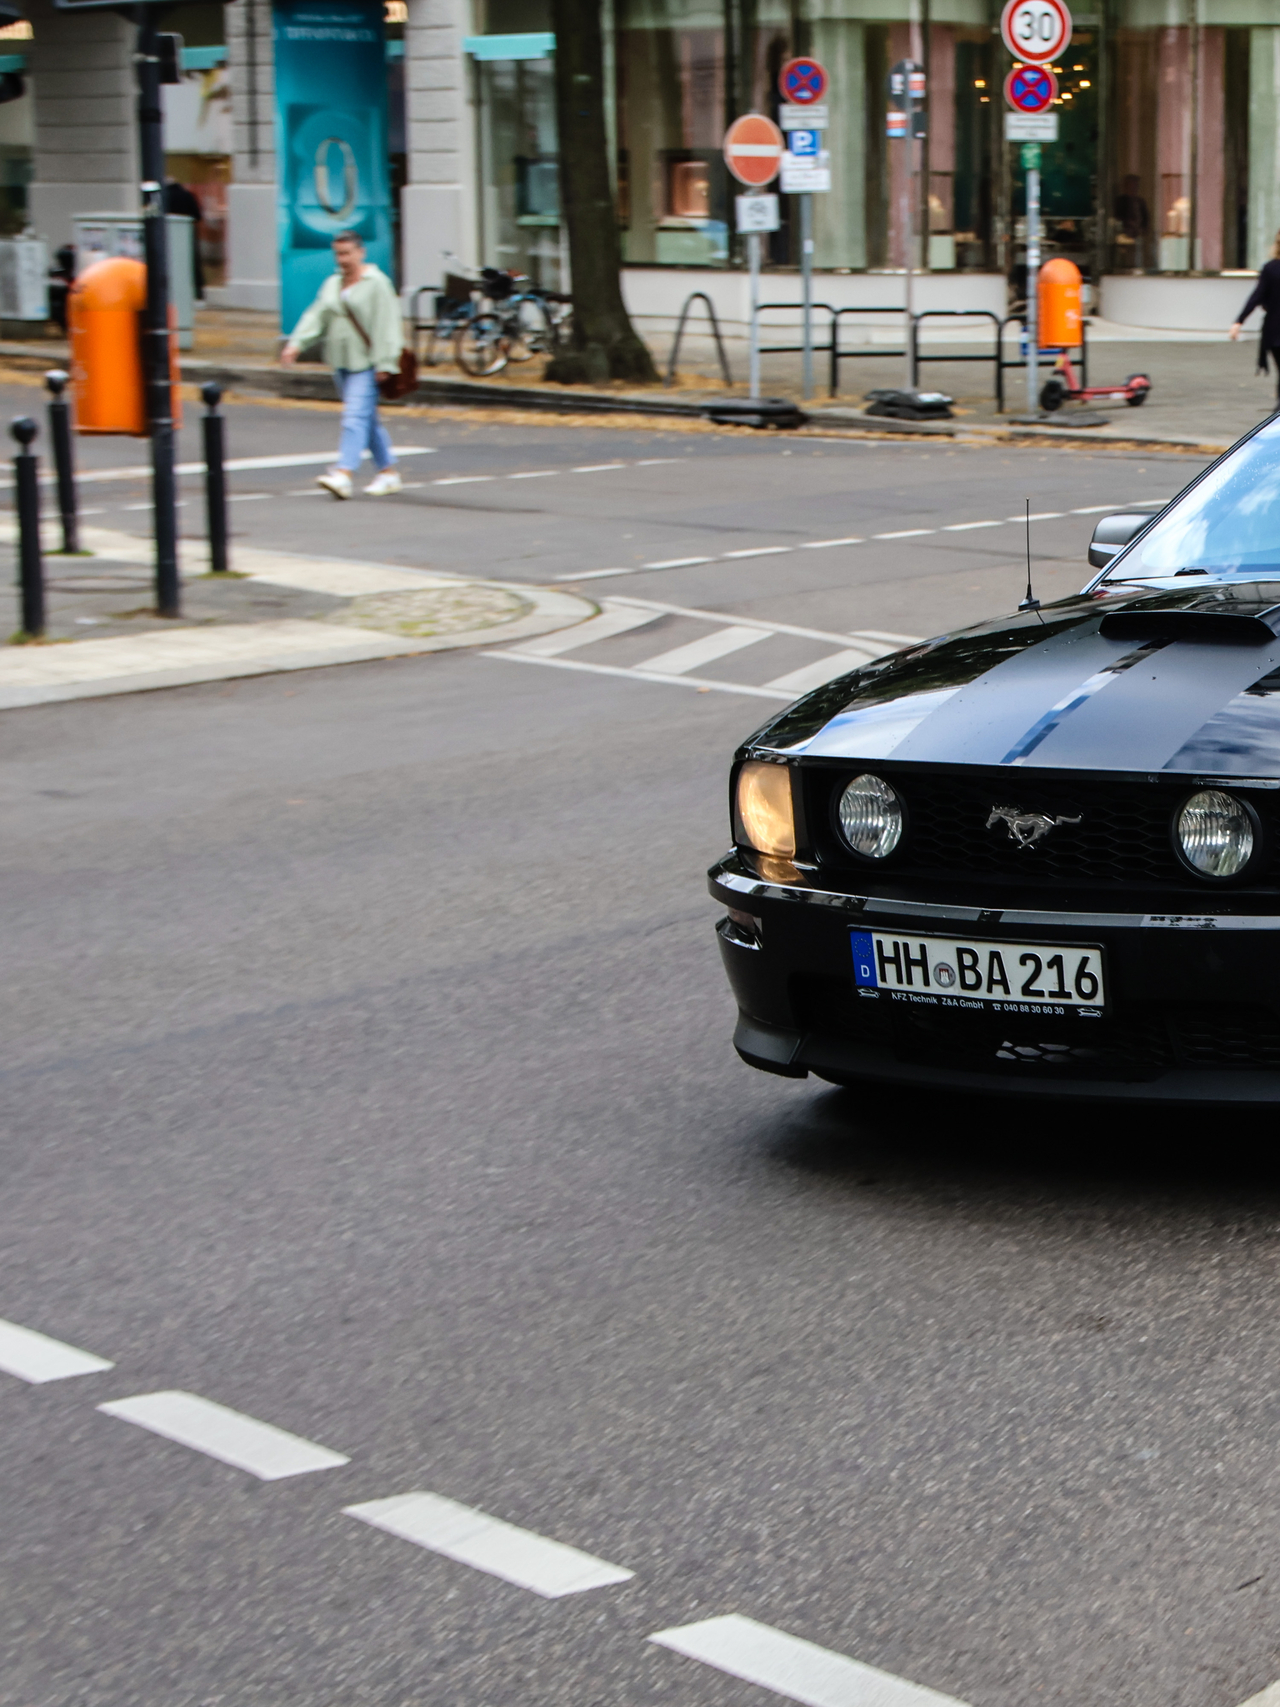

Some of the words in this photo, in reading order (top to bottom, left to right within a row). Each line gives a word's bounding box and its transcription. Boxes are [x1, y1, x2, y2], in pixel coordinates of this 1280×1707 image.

[1018, 10, 1055, 42] 30
[792, 131, 813, 155] P
[860, 965, 870, 977] D
[876, 939, 931, 987] HH
[956, 946, 1011, 995] BA
[1019, 952, 1099, 1001] 216
[891, 991, 908, 1001] KFZ
[909, 993, 938, 1004] Technik
[941, 997, 959, 1007] Z&A
[960, 999, 984, 1010] GmbH
[1003, 1003, 1018, 1012] 040
[1019, 1004, 1030, 1013] 88
[1031, 1005, 1041, 1014] 30
[1042, 1005, 1053, 1015] 60
[1054, 1006, 1065, 1015] 30
